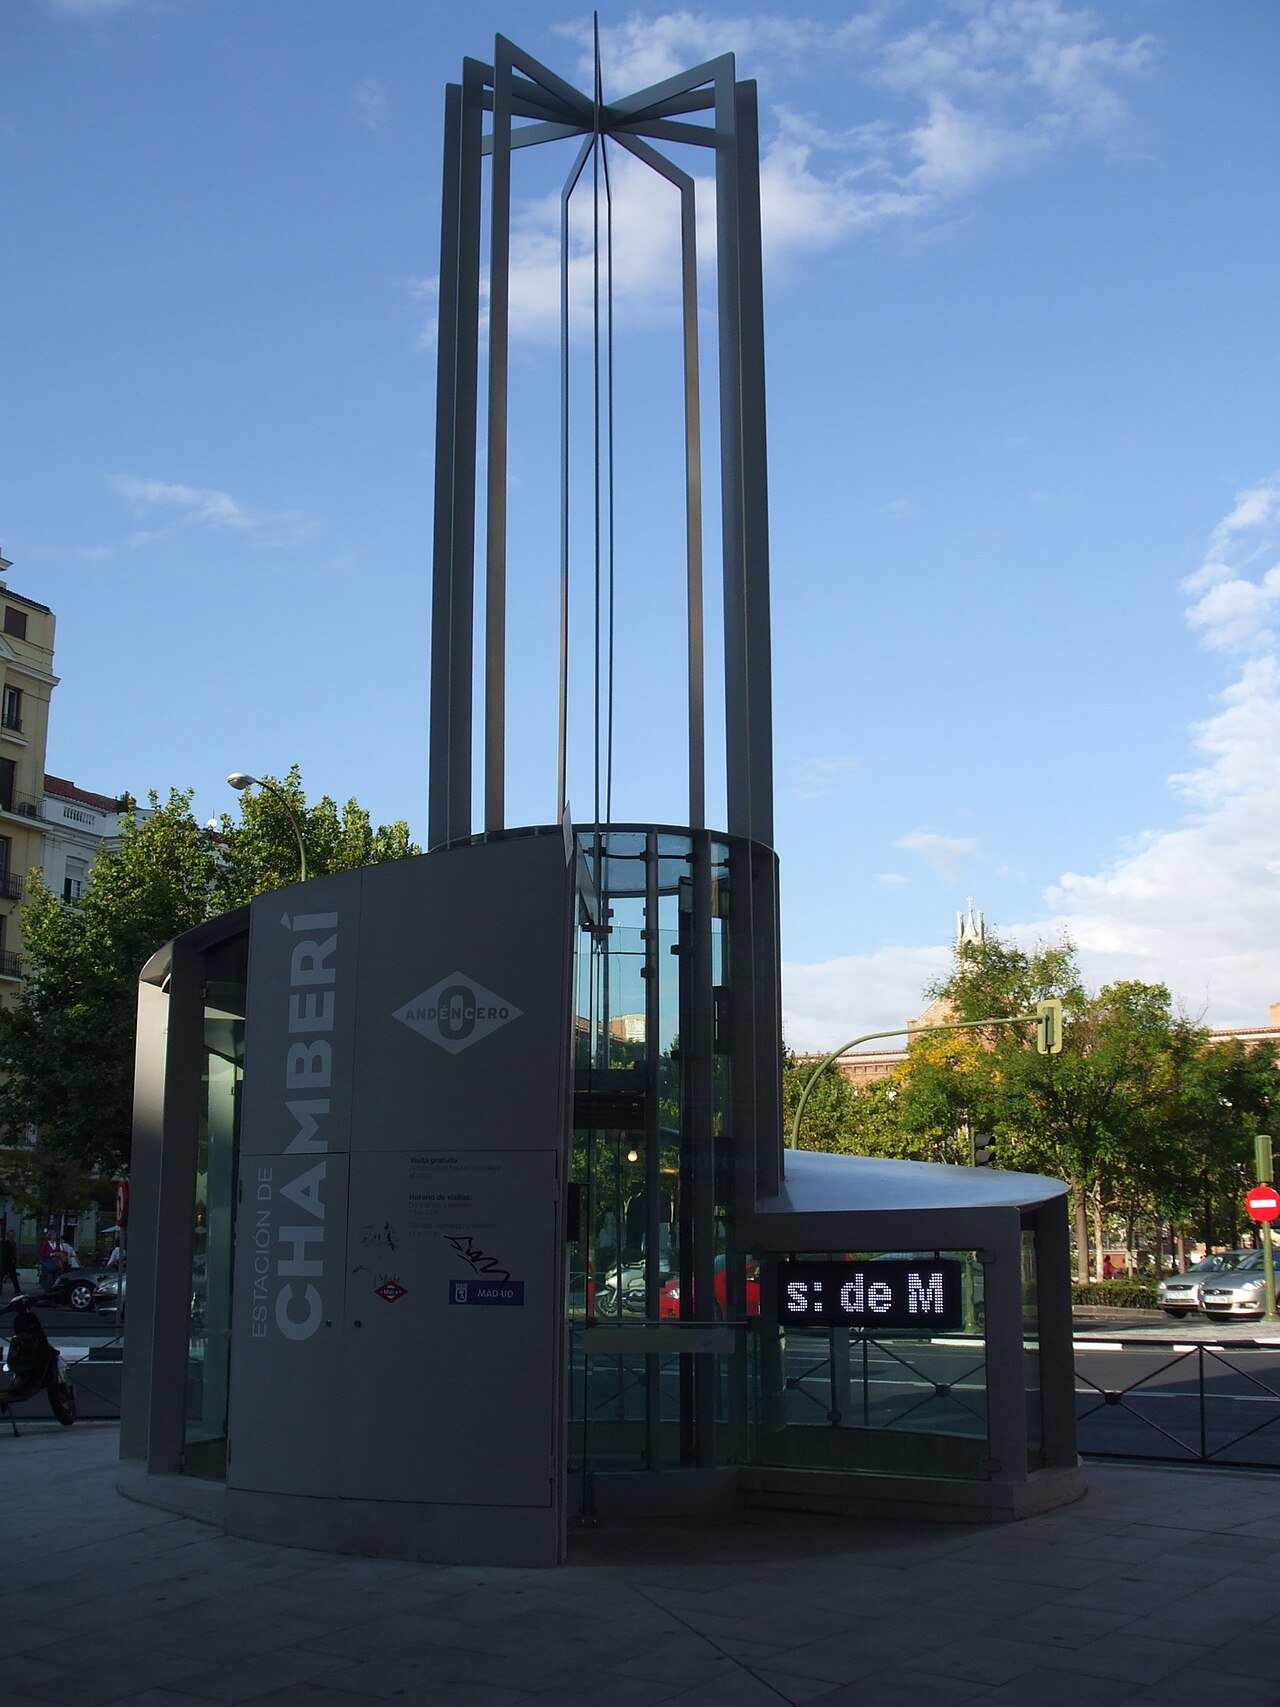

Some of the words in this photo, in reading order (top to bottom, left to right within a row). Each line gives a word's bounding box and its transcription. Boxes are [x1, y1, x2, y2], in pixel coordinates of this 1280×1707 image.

[275, 911, 338, 1341] CHAMBERÍ
[257, 1167, 273, 1200] DE
[252, 1210, 271, 1338] ESTACIÓN
[477, 1289, 514, 1298] MADRID
[840, 1273, 892, 1313] de
[908, 1273, 944, 1313] M
